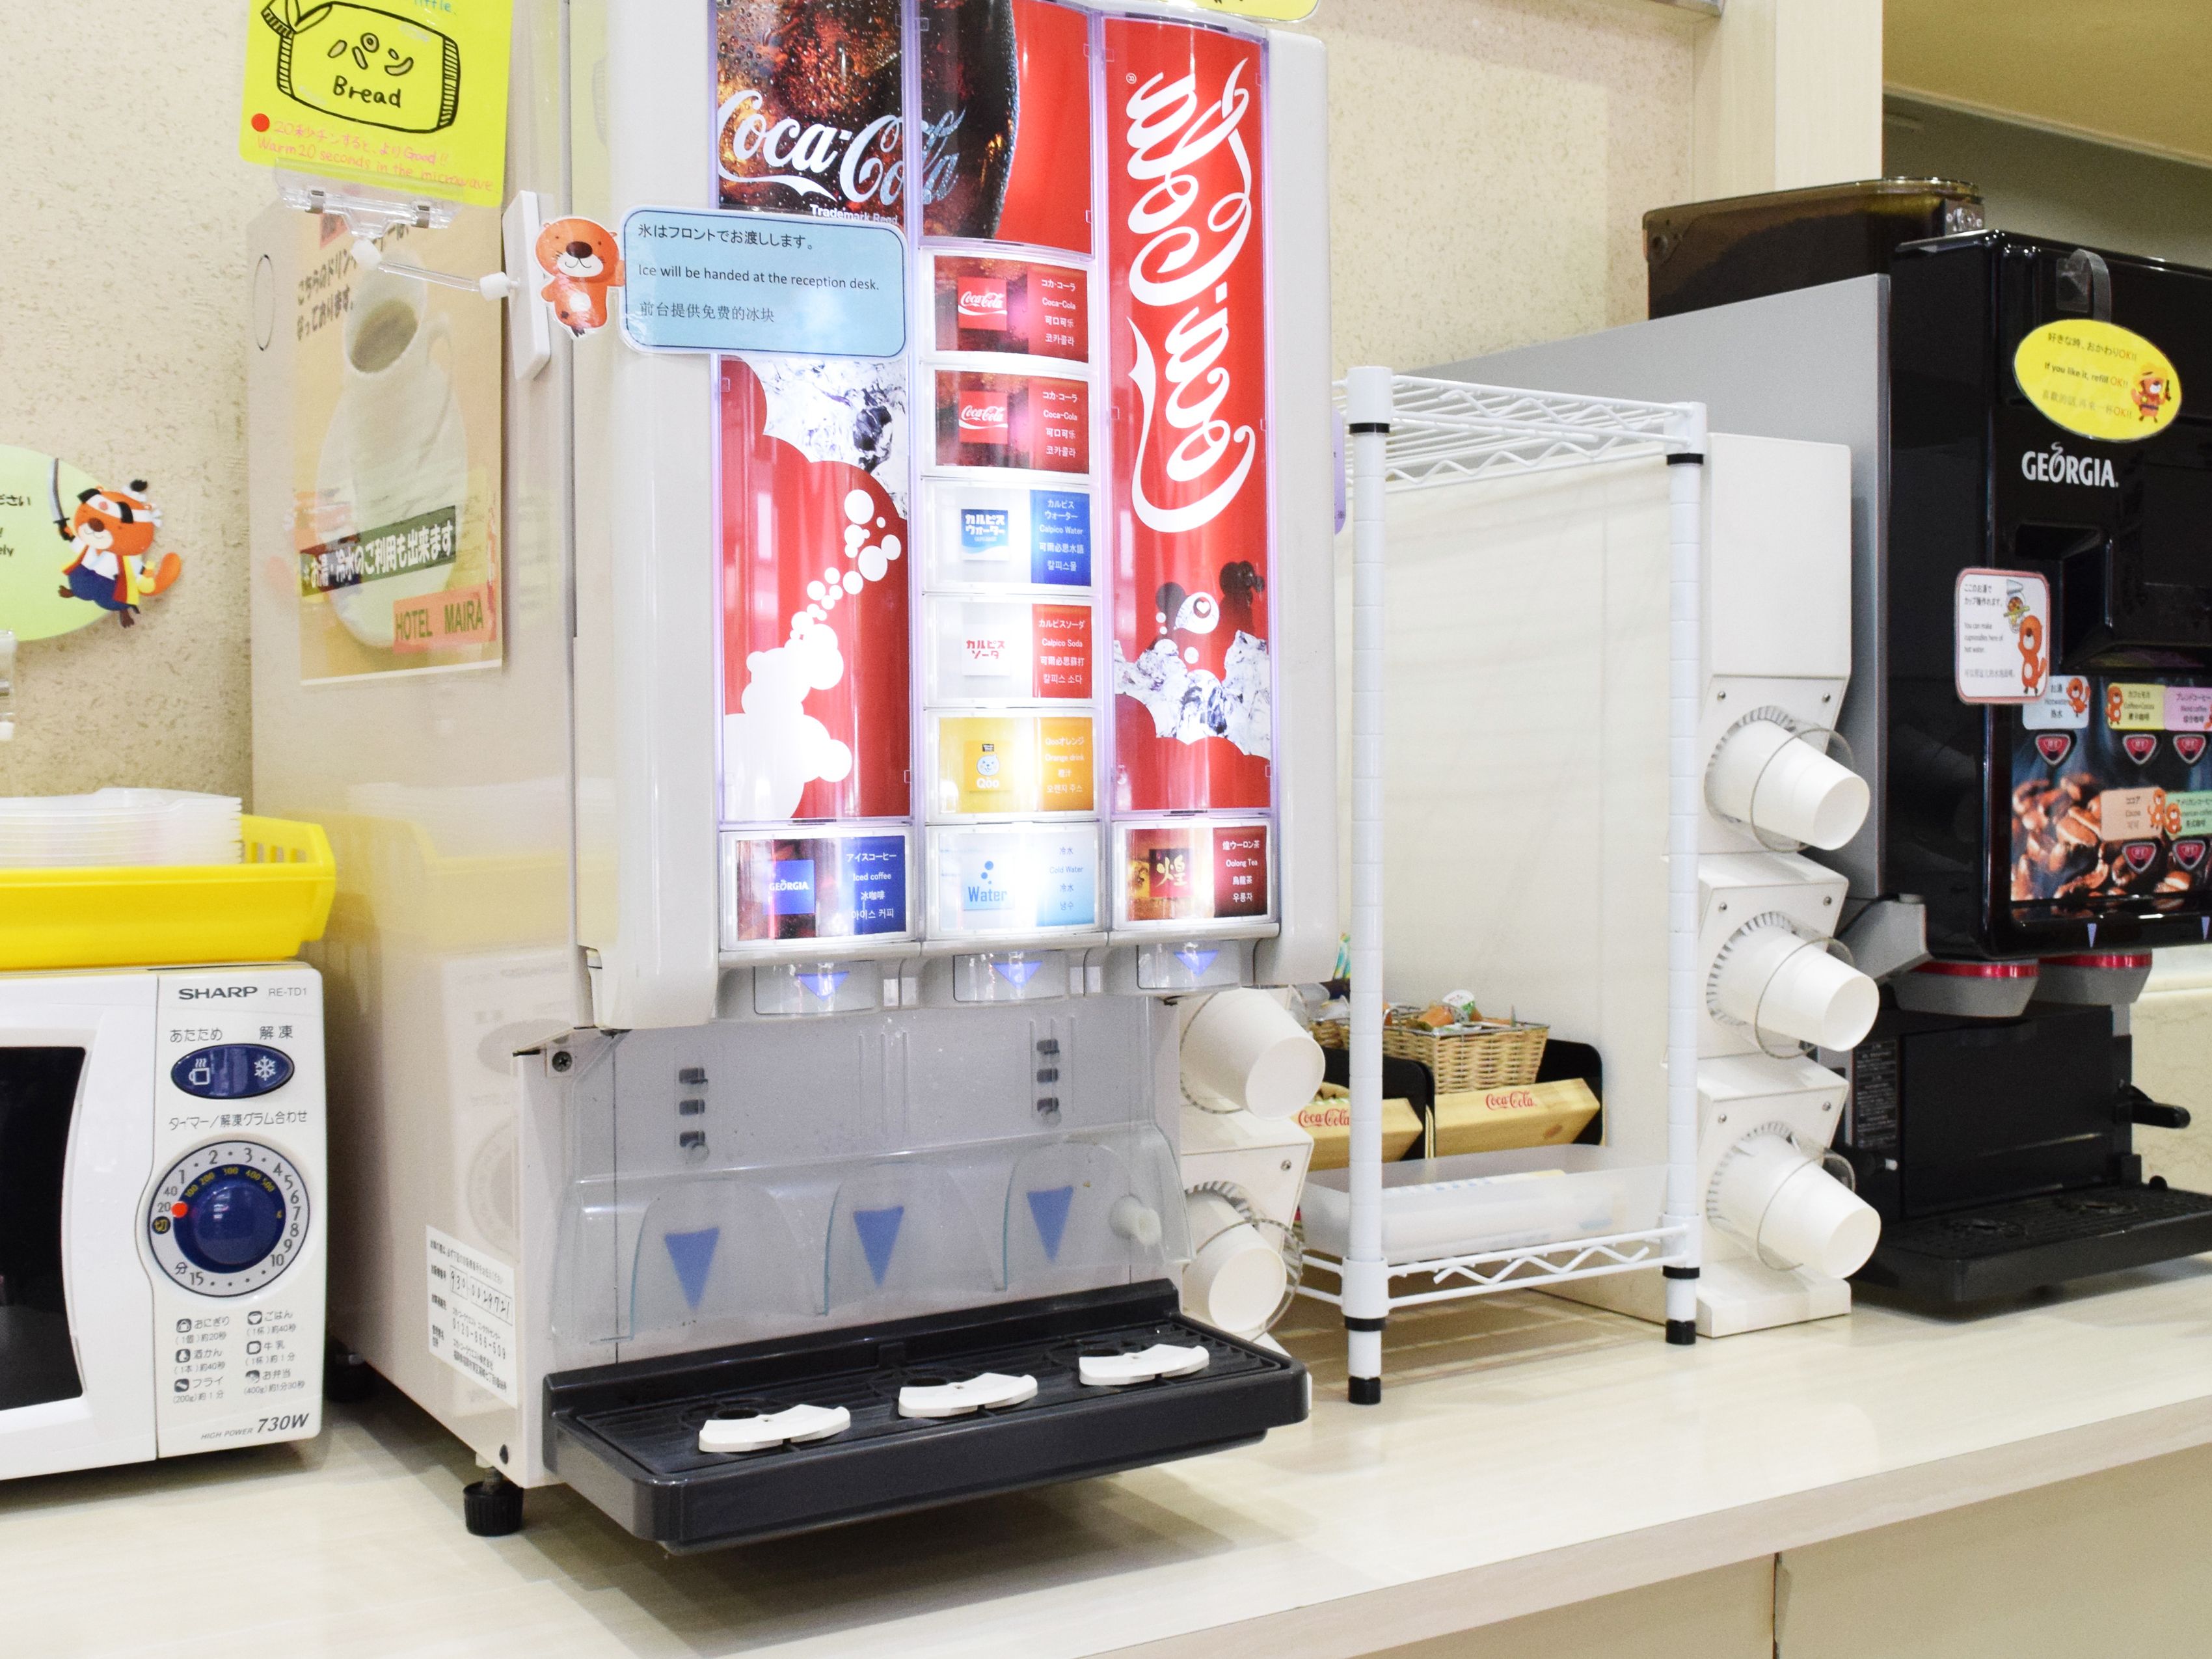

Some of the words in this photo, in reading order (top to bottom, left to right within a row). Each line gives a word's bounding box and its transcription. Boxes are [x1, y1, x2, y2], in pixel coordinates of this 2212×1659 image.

[332, 75, 401, 109] Bread
[717, 90, 967, 206] Coca-Cola
[258, 136, 297, 155] Warm
[299, 144, 316, 159] 20
[319, 150, 370, 169] seconds
[377, 160, 388, 173] in
[393, 163, 412, 178] the
[810, 204, 870, 223] Trademark
[638, 224, 813, 250] 氷はフロントでお渡しします。
[639, 265, 656, 276] Ice
[660, 266, 681, 278] will
[685, 267, 700, 278] be
[704, 268, 749, 282] handed
[753, 273, 764, 283] at
[768, 272, 787, 284] the
[791, 275, 846, 290] reception
[850, 278, 880, 291] desk.
[960, 291, 1005, 309] Coca-Cola
[1127, 57, 1255, 533] Coca-Cola
[1042, 297, 1075, 310] Coca-Cola
[640, 302, 774, 322] 前台提供免费的冰块
[1045, 333, 1074, 346] 코카콜라
[2051, 365, 2066, 373] you
[2068, 367, 2081, 376] like
[2092, 375, 2109, 383] refill
[961, 404, 1005, 422] Coca-Cola
[1044, 409, 1077, 421] Coca-Cola
[1046, 446, 1076, 458] 코카콜라
[2021, 449, 2118, 488] GEORGIA
[965, 514, 1005, 525] カルピス
[1040, 524, 1063, 533] Calpico
[1065, 526, 1083, 535] Water
[395, 608, 433, 641] HOTEL
[444, 599, 484, 634] MAIRA
[966, 640, 1005, 649] カルピス
[1042, 638, 1065, 647] Calpico
[1067, 639, 1083, 647] Soda
[1045, 754, 1068, 762] Orange
[846, 853, 897, 862] アイスコーヒー
[1059, 846, 1073, 855] 冷水
[1226, 859, 1247, 867] Oolong
[1155, 854, 1188, 887] 煌
[769, 880, 810, 891] GEORGIA
[968, 886, 1007, 902] Water
[878, 908, 895, 919] 커피
[178, 986, 258, 1000] SHARP
[268, 988, 307, 997] RE-TD1
[169, 1028, 223, 1043] あたため
[1486, 1090, 1535, 1110] Coca-Cola
[1298, 1109, 1349, 1128] Coca-Cola
[209, 1150, 218, 1165] 2
[244, 1148, 252, 1163] 3
[273, 1162, 283, 1176] 4
[179, 1169, 185, 1184] 1
[199, 1172, 216, 1185] 200
[284, 1174, 293, 1190] 5
[164, 1187, 178, 1196] 40
[184, 1184, 198, 1197] 100
[291, 1189, 299, 1203] 6
[157, 1202, 171, 1213] 20
[293, 1206, 301, 1221] 7
[290, 1223, 299, 1237] 8
[284, 1239, 293, 1254] 9
[270, 1253, 284, 1267] 10
[174, 1261, 188, 1275] 分
[190, 1272, 204, 1286] 15
[195, 1316, 229, 1329] おにぎり
[265, 1310, 293, 1321] ごはん
[262, 1368, 291, 1380] お弁当
[193, 1375, 223, 1388] フライ
[224, 1427, 253, 1437] POWER
[257, 1412, 309, 1433] 730W
